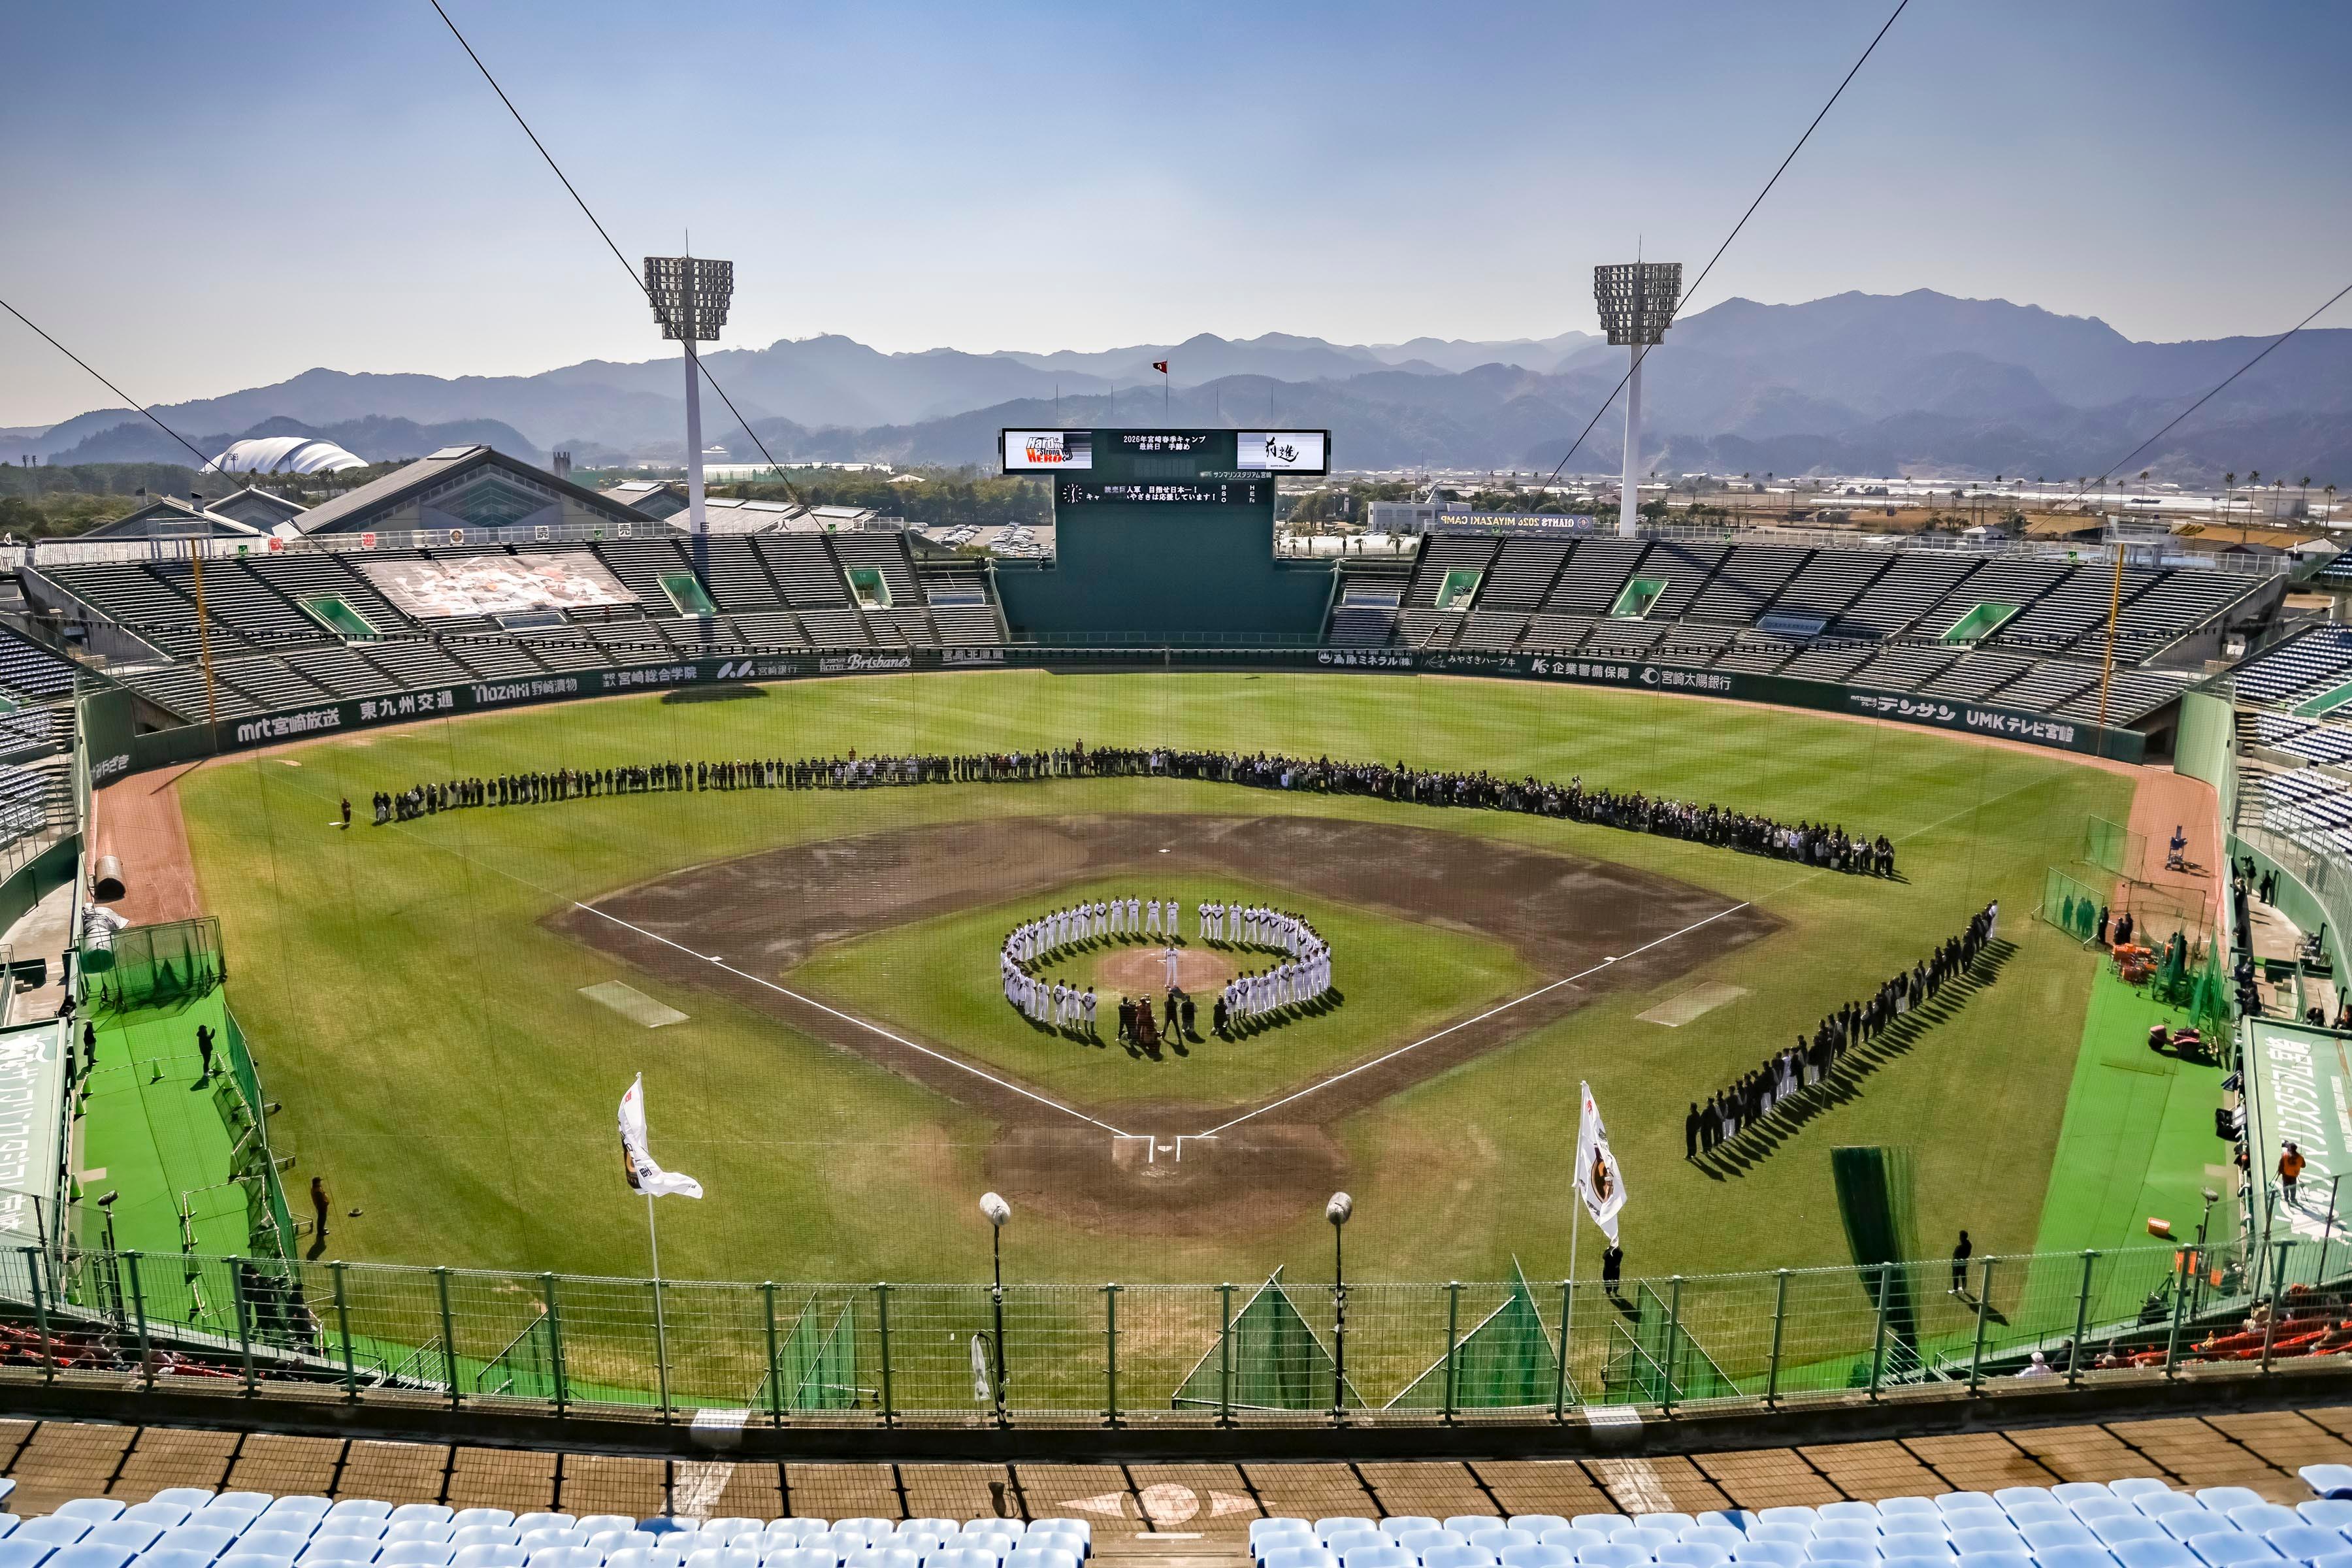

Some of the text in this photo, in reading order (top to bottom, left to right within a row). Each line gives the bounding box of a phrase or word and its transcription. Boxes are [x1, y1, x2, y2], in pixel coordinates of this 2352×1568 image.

[779, 520, 789, 531] 人
[847, 653, 912, 670] Brisbane's
[1552, 662, 1629, 680] 企業警備保障
[618, 666, 698, 686] 宮崎総合学院
[1661, 671, 1732, 691] 宮崎太陽銀行
[359, 690, 454, 720] 東九州交通
[1967, 710, 2074, 743] UMK テレビ宮崎
